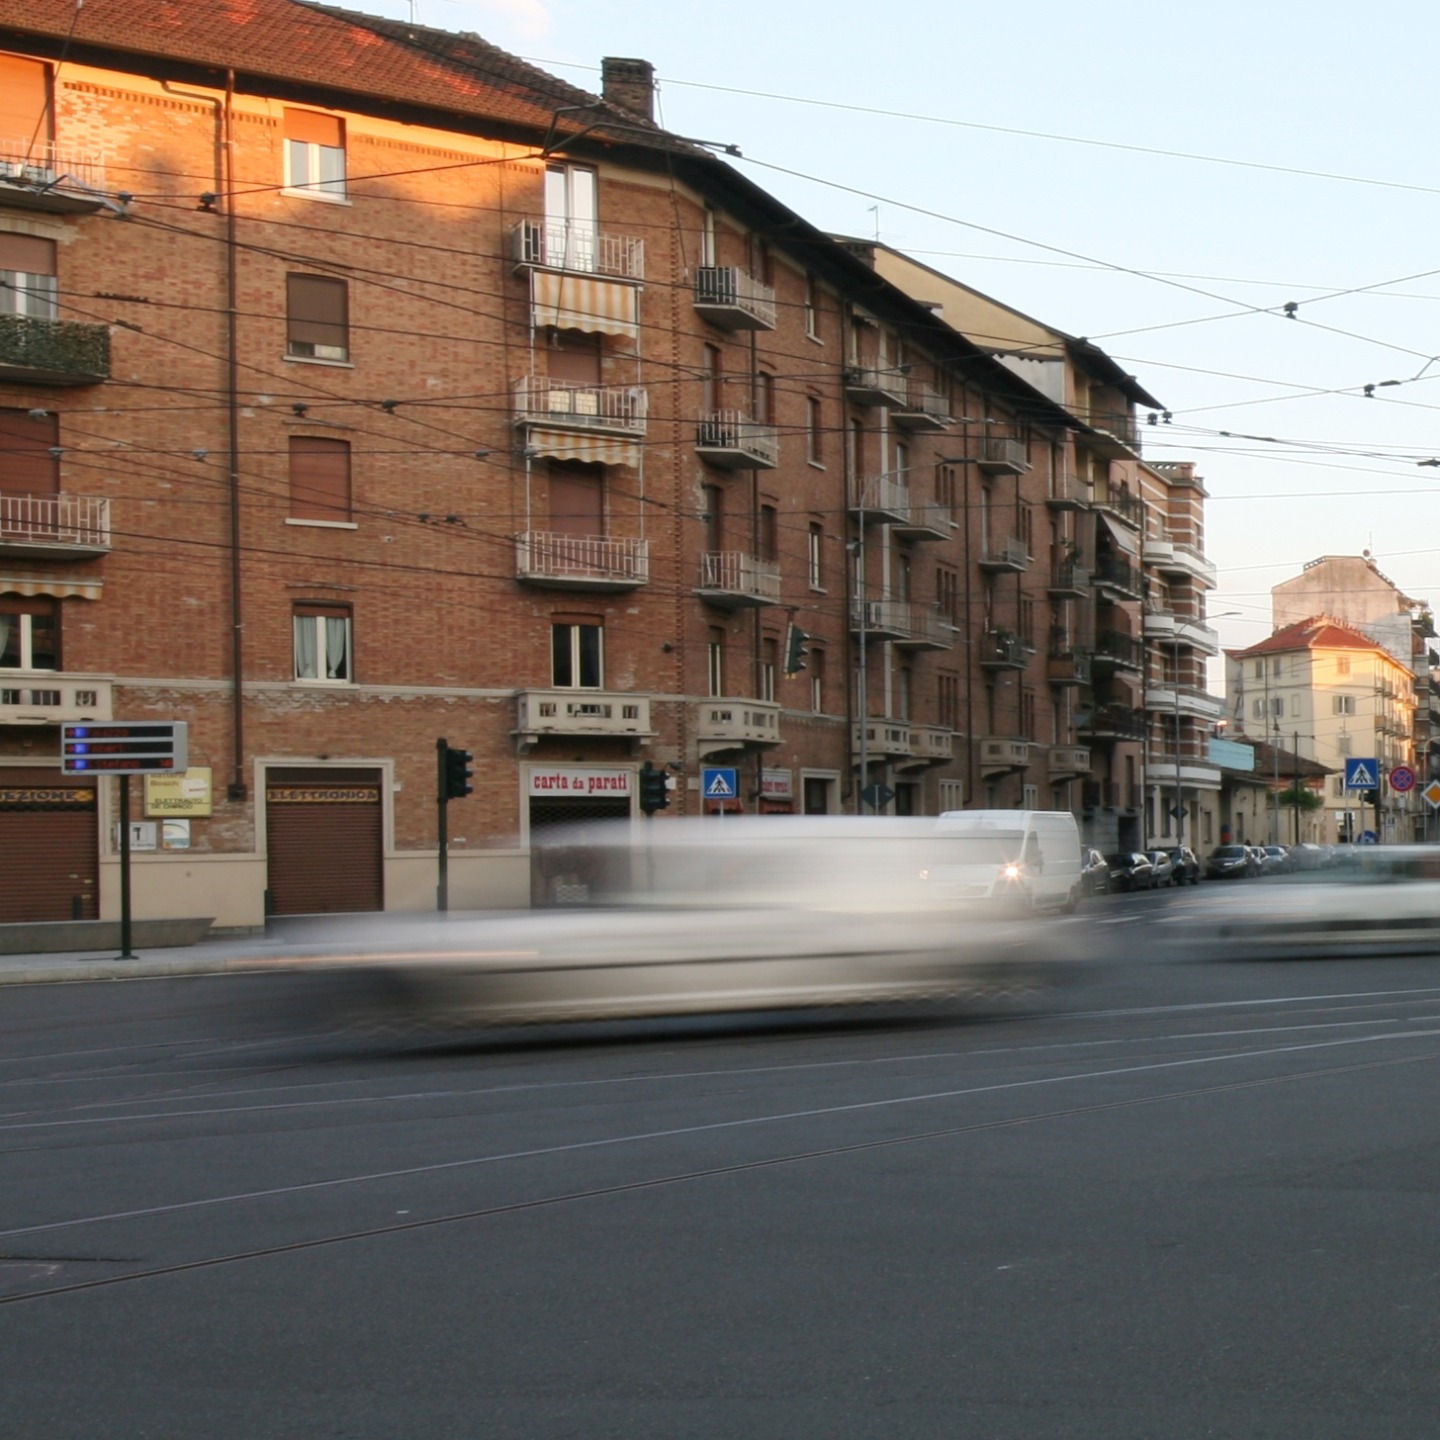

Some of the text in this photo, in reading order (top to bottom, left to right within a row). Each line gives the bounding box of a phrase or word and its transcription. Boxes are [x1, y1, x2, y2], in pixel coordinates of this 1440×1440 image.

[533, 773, 627, 793] carta da parati
[269, 790, 378, 800] ELETTRONICA
